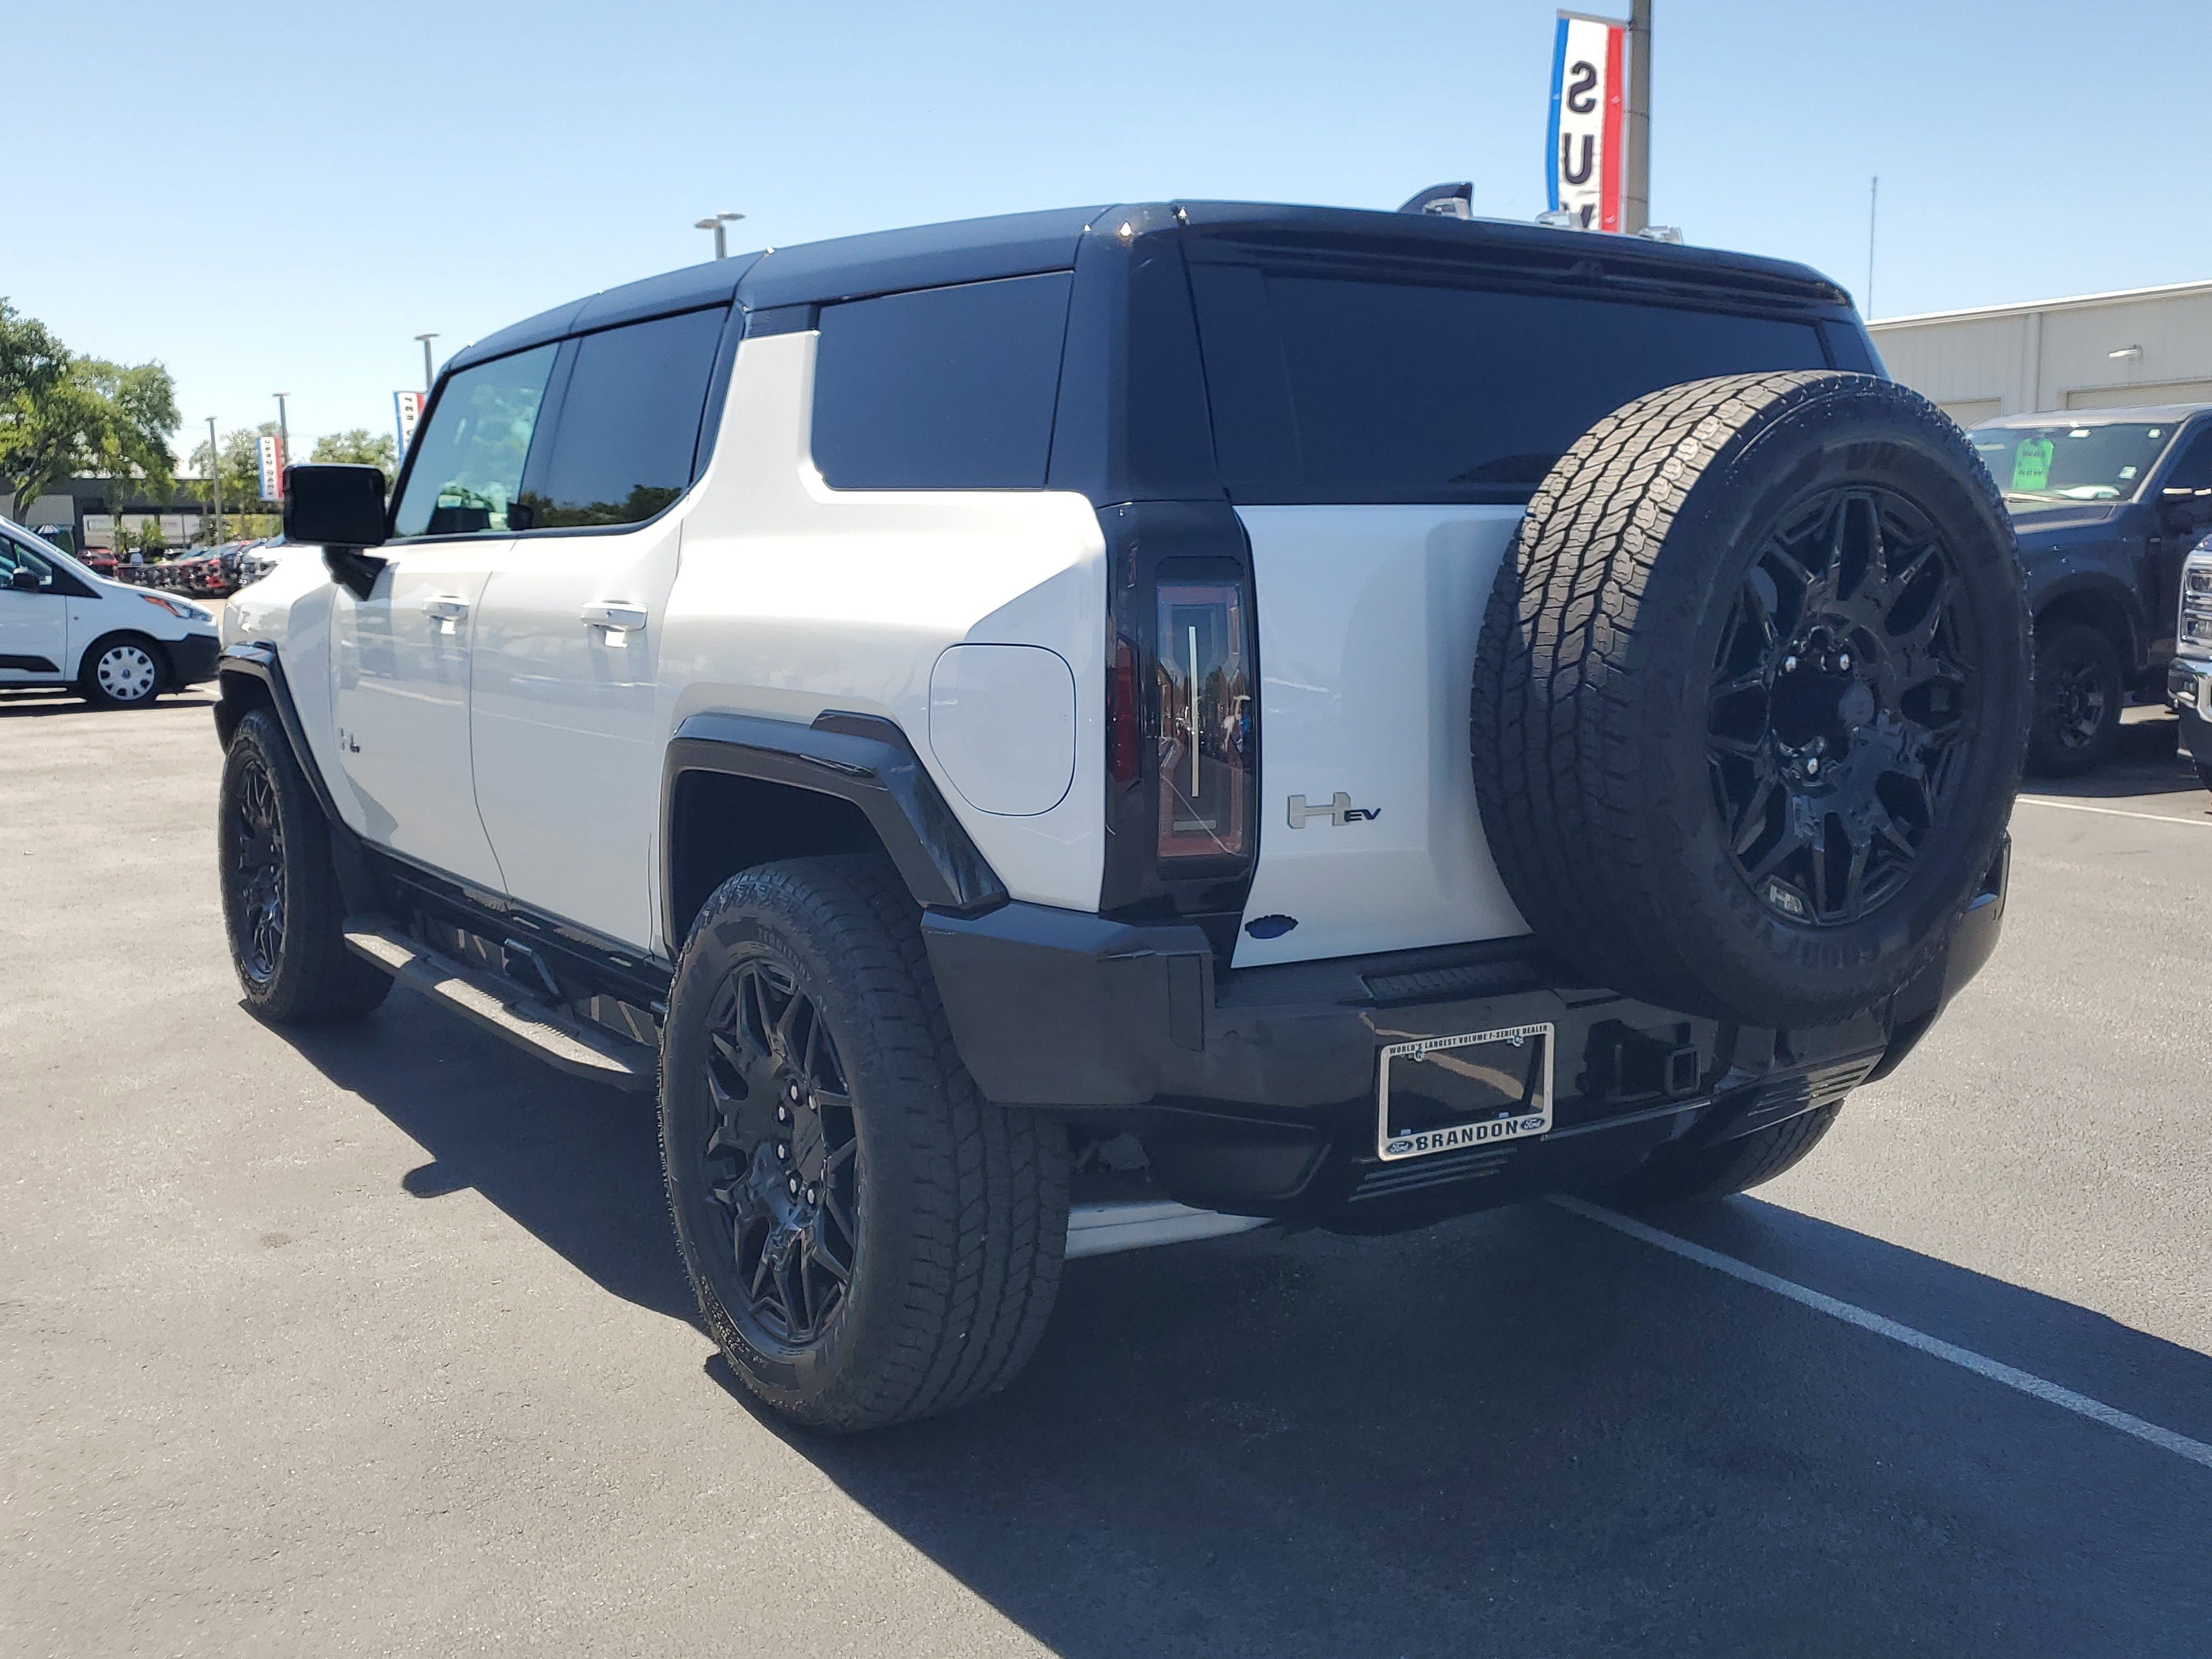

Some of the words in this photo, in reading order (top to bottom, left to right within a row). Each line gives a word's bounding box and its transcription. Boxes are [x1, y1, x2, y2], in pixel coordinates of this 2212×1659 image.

[1390, 1043, 1423, 1054] WORLD'S
[1425, 1038, 1456, 1049] LARGEST
[1459, 1033, 1487, 1043] VOLUME
[1489, 1029, 1520, 1039] F-SERIES
[1522, 1025, 1548, 1034] DEALER
[1390, 1141, 1410, 1153] Ford
[1415, 1120, 1518, 1150] BRANDON
[1523, 1118, 1541, 1130] Ford
